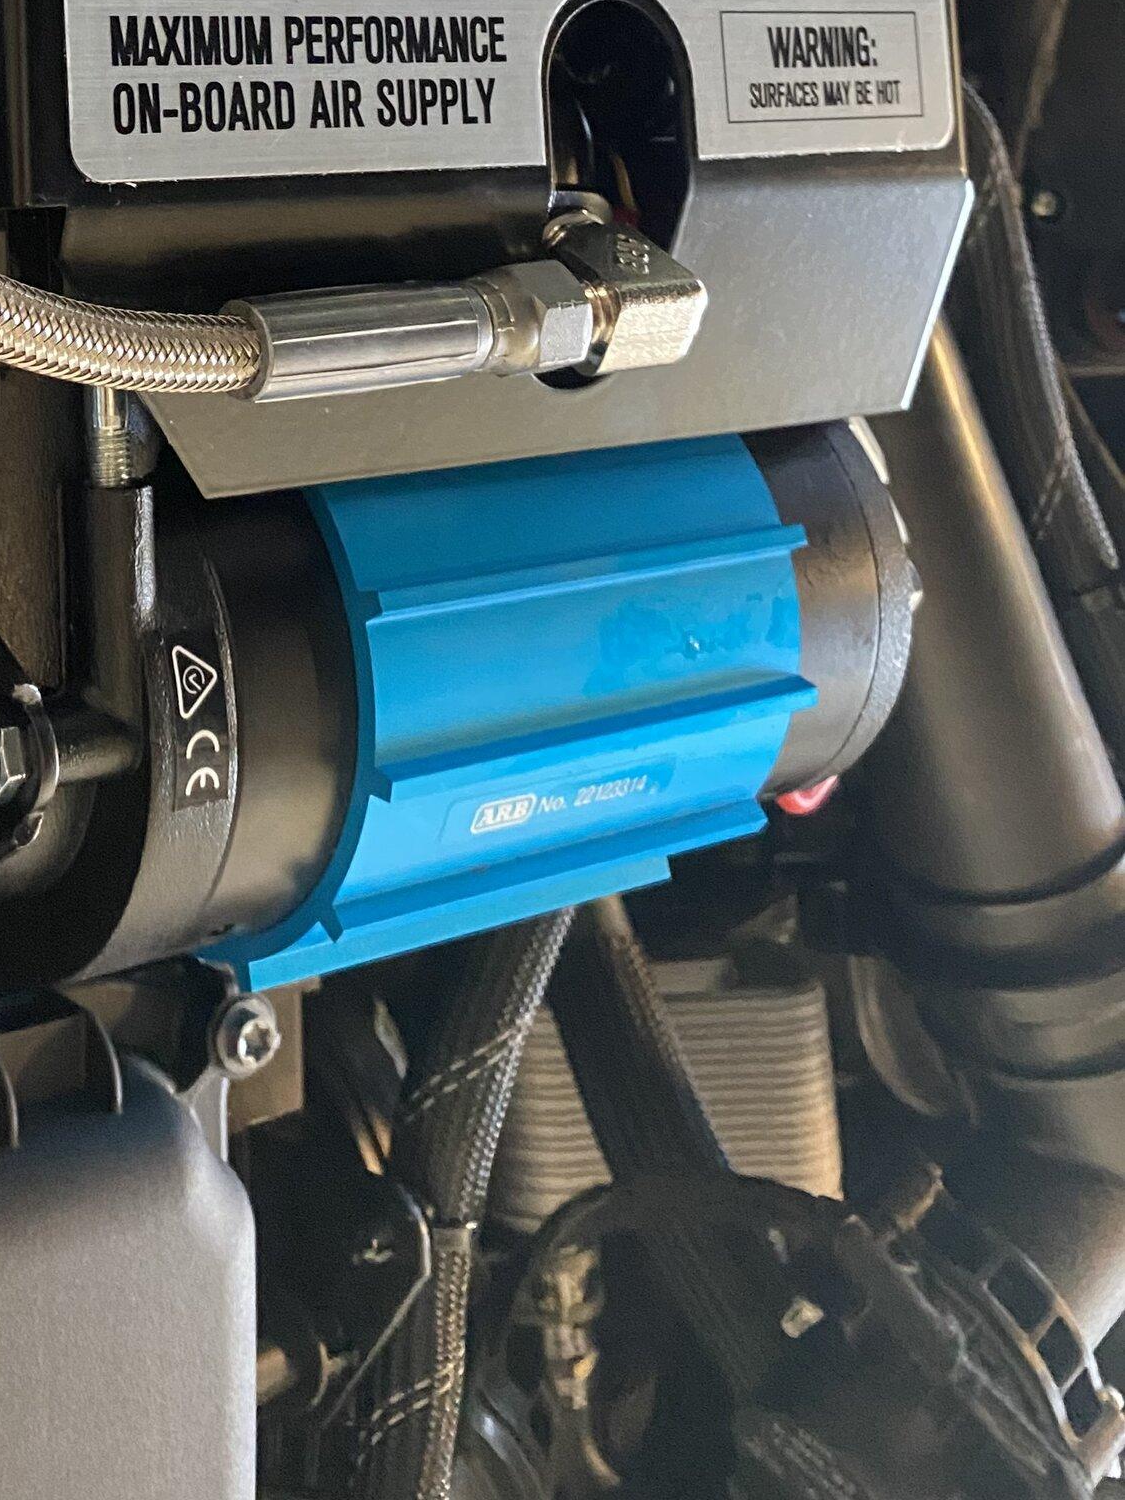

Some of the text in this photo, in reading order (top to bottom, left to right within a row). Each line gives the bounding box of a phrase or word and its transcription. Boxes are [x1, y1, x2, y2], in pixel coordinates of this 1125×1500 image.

[110, 15, 507, 66] MAXIMUM PERFORMANCE
[767, 26, 878, 68] WARNING:
[113, 77, 496, 135] ON-BOARD AIR SUPPLY
[749, 79, 901, 108] SURFACES MAY BE HOT
[186, 729, 220, 796] CE
[475, 799, 531, 830] ARB
[537, 795, 567, 814] No.
